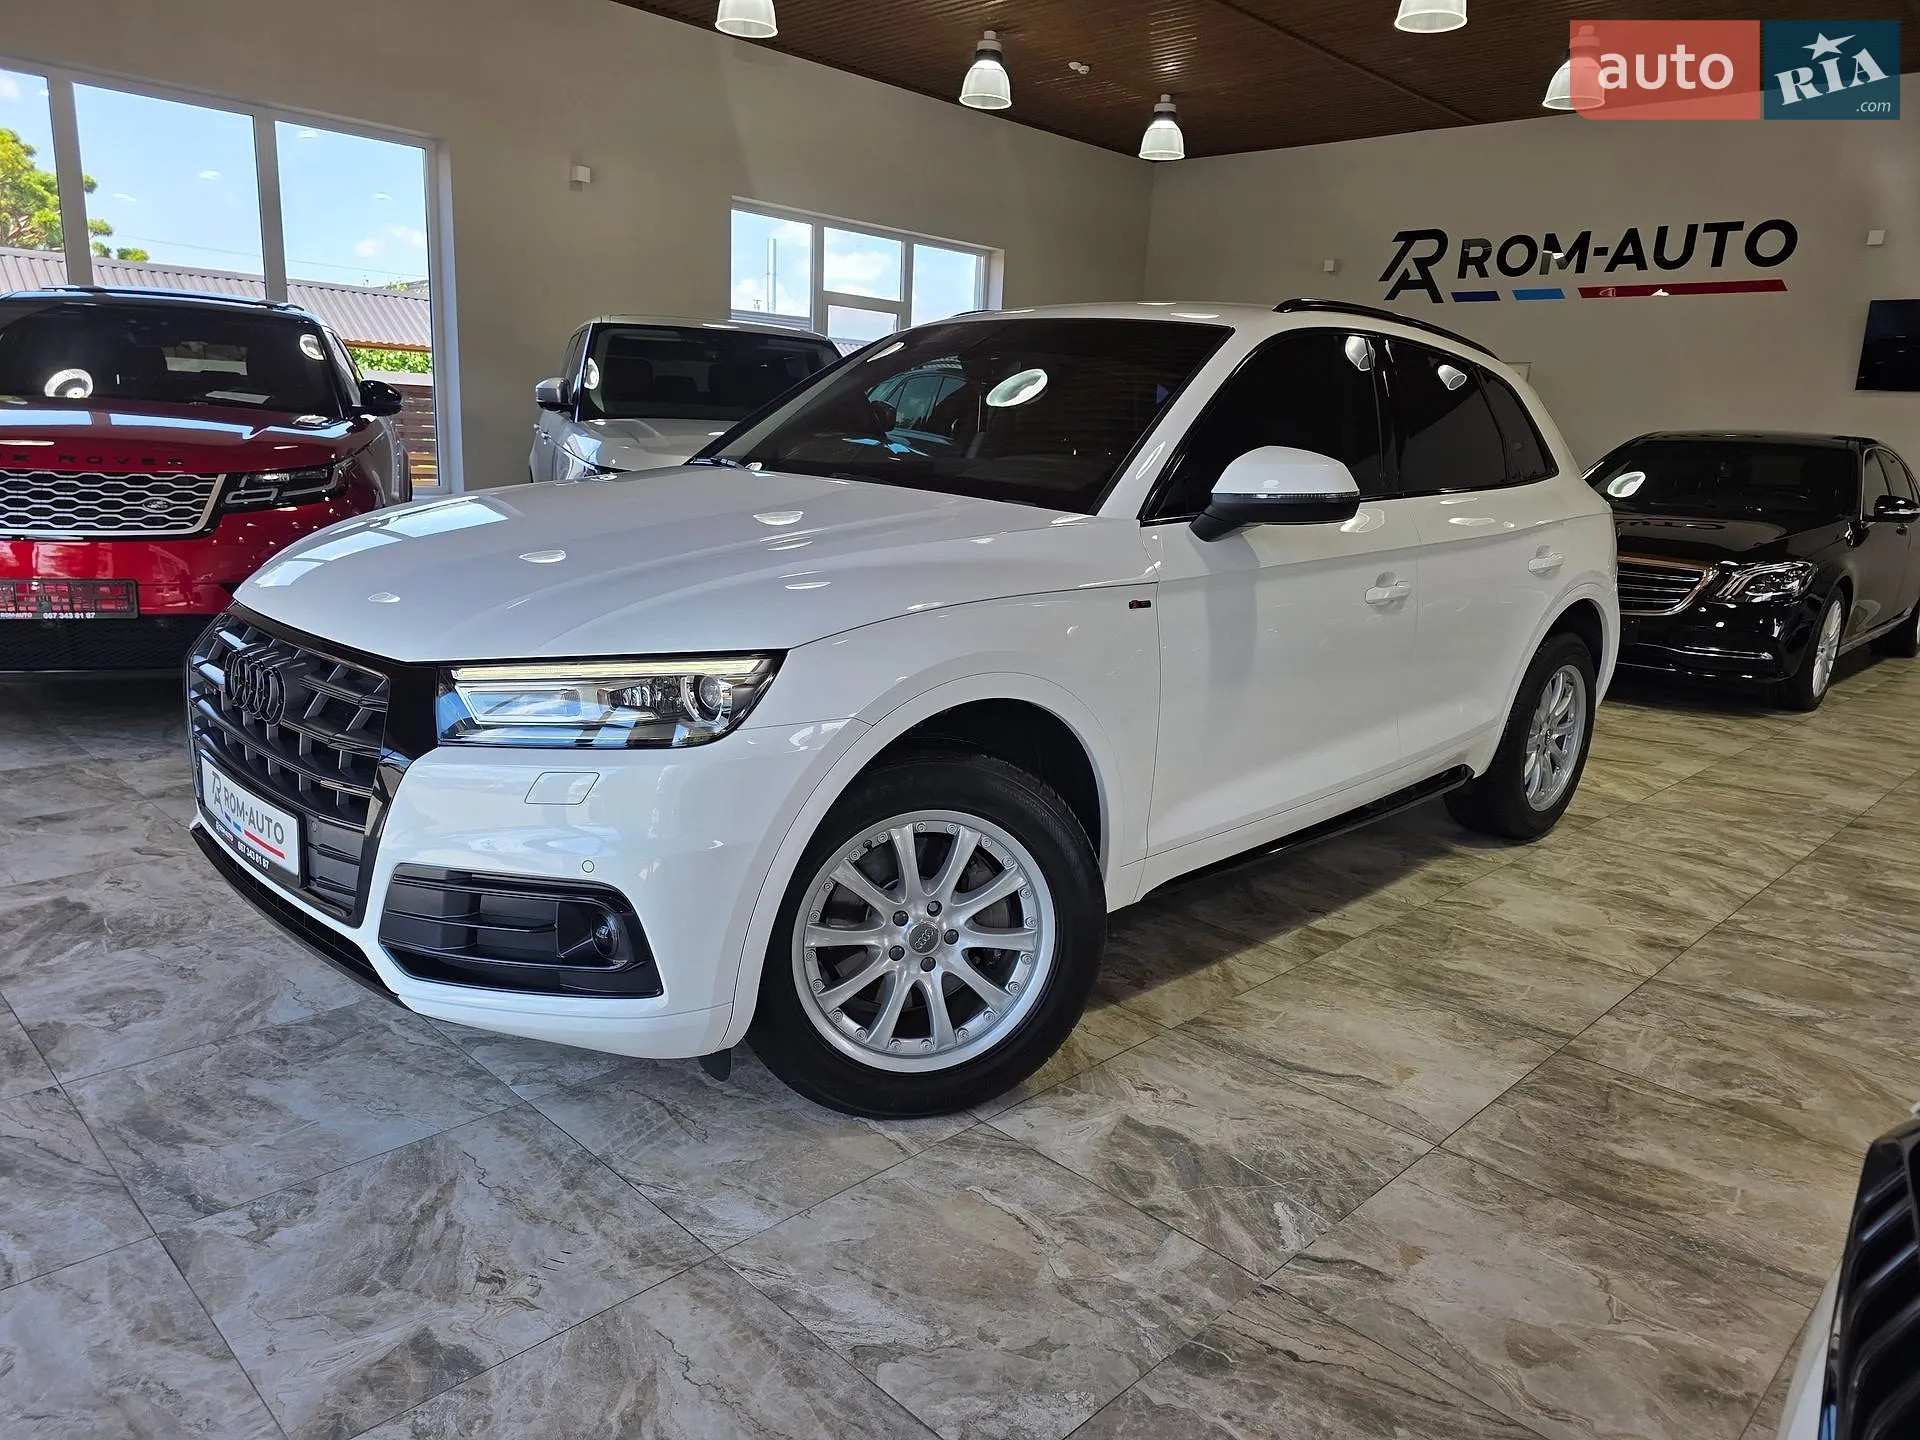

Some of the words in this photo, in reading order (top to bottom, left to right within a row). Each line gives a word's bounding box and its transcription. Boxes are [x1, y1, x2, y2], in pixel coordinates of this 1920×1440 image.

[1457, 219, 1799, 280] ROM-AUTO
[57, 453, 185, 467] ROVER
[223, 785, 285, 845] ROM-AUTO
